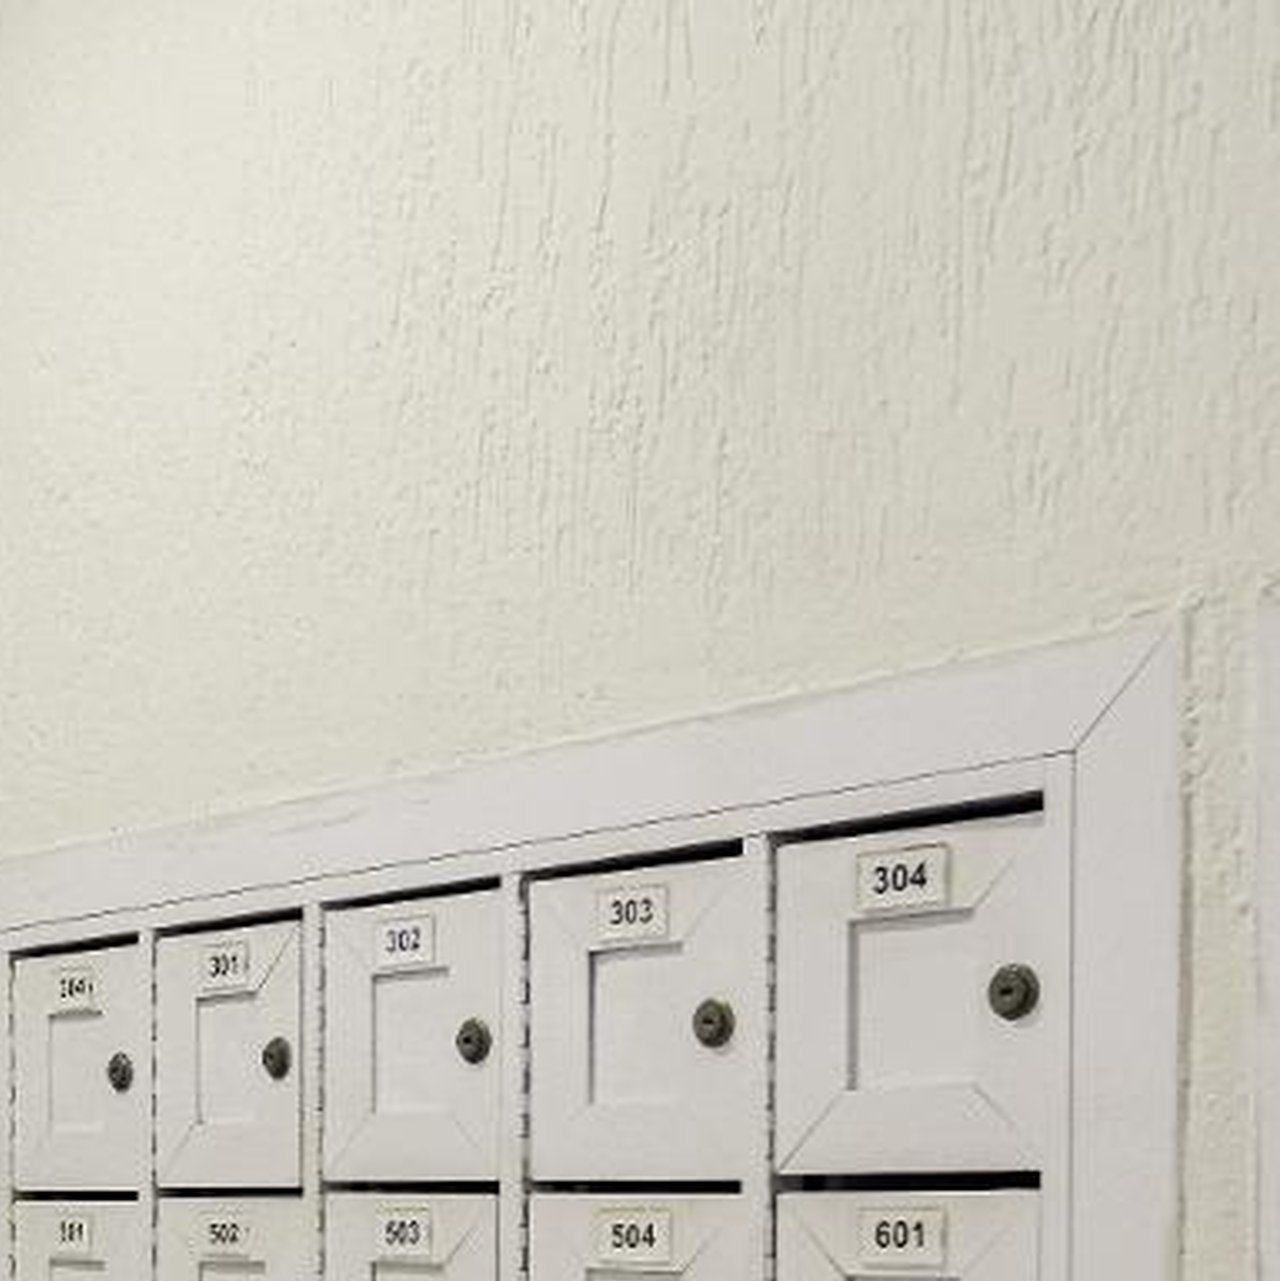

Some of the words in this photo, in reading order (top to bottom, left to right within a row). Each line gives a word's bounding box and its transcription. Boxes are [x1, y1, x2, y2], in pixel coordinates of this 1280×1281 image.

[873, 863, 927, 894] 304
[610, 899, 654, 925] 303
[385, 927, 420, 952] 302
[209, 1223, 239, 1243] 502
[385, 1220, 420, 1246] 503
[611, 1223, 655, 1249] 504
[875, 1221, 926, 1248] 601
